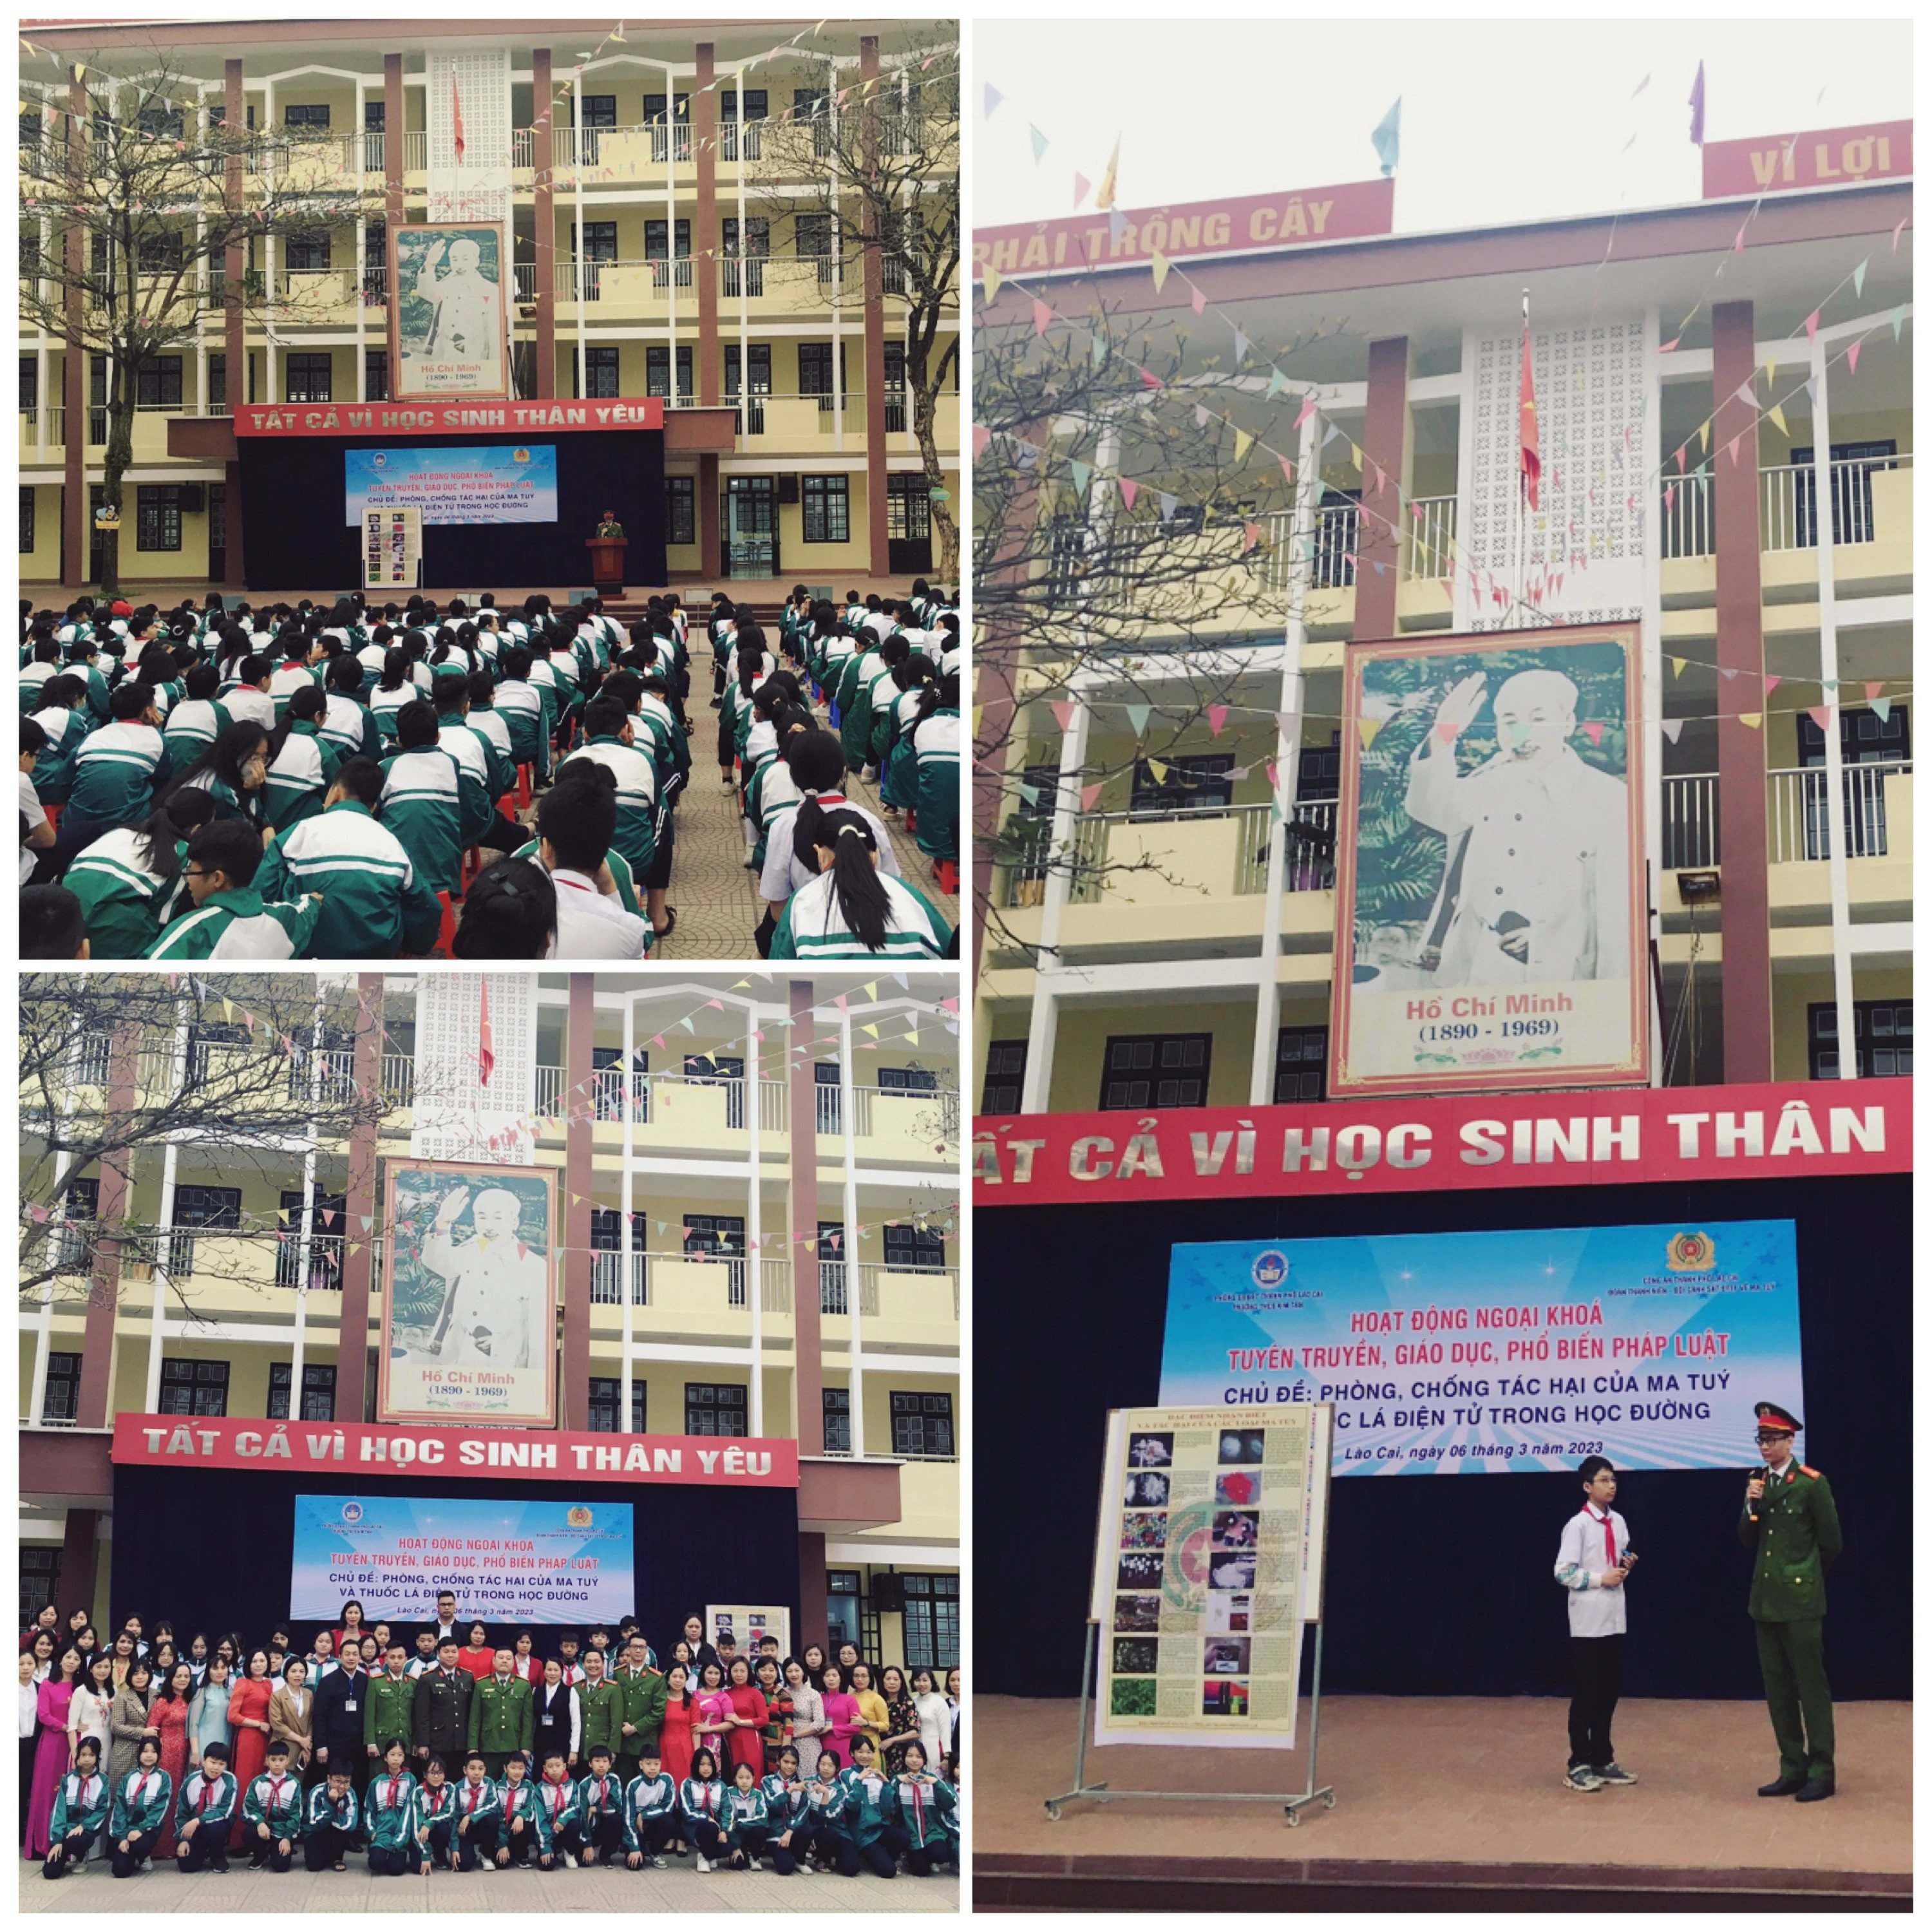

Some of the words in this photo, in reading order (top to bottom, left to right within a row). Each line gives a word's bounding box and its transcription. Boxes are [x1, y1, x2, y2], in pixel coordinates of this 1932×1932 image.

[1750, 140, 1795, 185] VÌ
[1815, 135, 1891, 181] LỢI
[1086, 207, 1231, 260] TRỒNG
[1250, 197, 1334, 242] CÂY
[457, 363, 481, 372] Minh
[251, 408, 296, 430] TẤT
[306, 407, 341, 429] CẢ
[348, 408, 372, 428] VÌ
[382, 410, 434, 430] HỌC
[442, 410, 505, 426] SINH
[513, 406, 585, 425] THÂN
[595, 404, 645, 424] YÊU
[1406, 996, 1443, 1019] Hồ
[1452, 996, 1496, 1018] Chí
[1506, 992, 1573, 1014] Minh
[1419, 1023, 1478, 1043] (1890
[1501, 1019, 1558, 1037] 1969)
[972, 1124, 1045, 1184] ẤT
[1069, 1118, 1164, 1180] CẢ
[1189, 1120, 1256, 1175] VÌ
[1282, 1123, 1433, 1180] HỌC
[1459, 1115, 1640, 1165] SINH
[1667, 1100, 1885, 1159] THÂN
[1350, 1311, 1404, 1337] HOẠT
[1411, 1305, 1468, 1335] ĐỘNG
[1477, 1306, 1539, 1332] NGOẠI
[1547, 1299, 1603, 1326] KHOÁ
[1229, 1344, 1294, 1371] TUYÊN
[1302, 1338, 1387, 1369] TRUYỀN,
[1396, 1339, 1443, 1365] GIÁO
[1452, 1341, 1499, 1367] DỤC,
[1508, 1330, 1549, 1361] PHỔ
[1557, 1330, 1604, 1360] BIẾN
[1612, 1330, 1668, 1358] PHÁP
[1675, 1329, 1728, 1361] LUẬT
[429, 1385, 462, 1395] (1890
[475, 1387, 507, 1396] 1969)
[448, 1371, 473, 1383] Chí
[478, 1372, 515, 1384] Minh
[1224, 1381, 1269, 1404] CHỦ
[1276, 1379, 1312, 1403] ĐỀ:
[1320, 1379, 1403, 1401] PHÒNG,
[1411, 1374, 1490, 1398] CHỐNG
[1498, 1374, 1541, 1396] TÁC
[1549, 1376, 1586, 1397] HẠI
[1593, 1369, 1639, 1393] CỦA
[1648, 1374, 1680, 1391] MA
[1688, 1368, 1730, 1390] TUÝ
[1359, 1406, 1386, 1428] LÁ
[1394, 1405, 1445, 1430] ĐIỆN
[1453, 1401, 1482, 1425] TỬ
[1489, 1406, 1566, 1425] TRONG
[1575, 1405, 1622, 1425] HỌC
[1630, 1399, 1710, 1421] ĐƯỜNG
[143, 1421, 221, 1455] TẤT
[234, 1424, 292, 1459] CẢ
[306, 1430, 345, 1461] VÌ
[360, 1436, 444, 1468] HỌC
[459, 1441, 556, 1468] SINH
[571, 1443, 681, 1473] THÂN
[696, 1446, 772, 1476] YÊU
[1345, 1448, 1371, 1459] Lào
[1377, 1446, 1403, 1459] Cai,
[1409, 1446, 1444, 1461] ngày
[1449, 1444, 1467, 1457] 06
[1472, 1444, 1513, 1459] tháng
[1518, 1443, 1527, 1455] 3
[1532, 1443, 1564, 1454] năm
[1568, 1442, 1603, 1454] 2023
[399, 1537, 428, 1551] HOẠT
[431, 1537, 462, 1552] ĐỘNG
[467, 1539, 500, 1553] NGOẠI
[331, 1551, 368, 1565] TUYÊN
[424, 1554, 449, 1567] GIÁO
[453, 1556, 479, 1569] DỤC,
[510, 1553, 534, 1568] BIẾN
[538, 1556, 567, 1569] PHÁP
[571, 1555, 598, 1571] LUẬT
[329, 1570, 354, 1582] CHỦ
[383, 1573, 428, 1584] PHÒNG,
[431, 1572, 475, 1584] CHỐNG
[478, 1575, 501, 1586] TÁC
[506, 1577, 525, 1587] HẠI
[528, 1574, 552, 1586] CỦA
[577, 1575, 598, 1586] TUÝ
[339, 1585, 355, 1596] VÀ
[359, 1585, 400, 1597] THUỐC
[404, 1586, 419, 1598] LÁ
[474, 1590, 515, 1600] TRONG
[519, 1590, 543, 1601] HỌC
[547, 1590, 588, 1601] ĐƯỜNG
